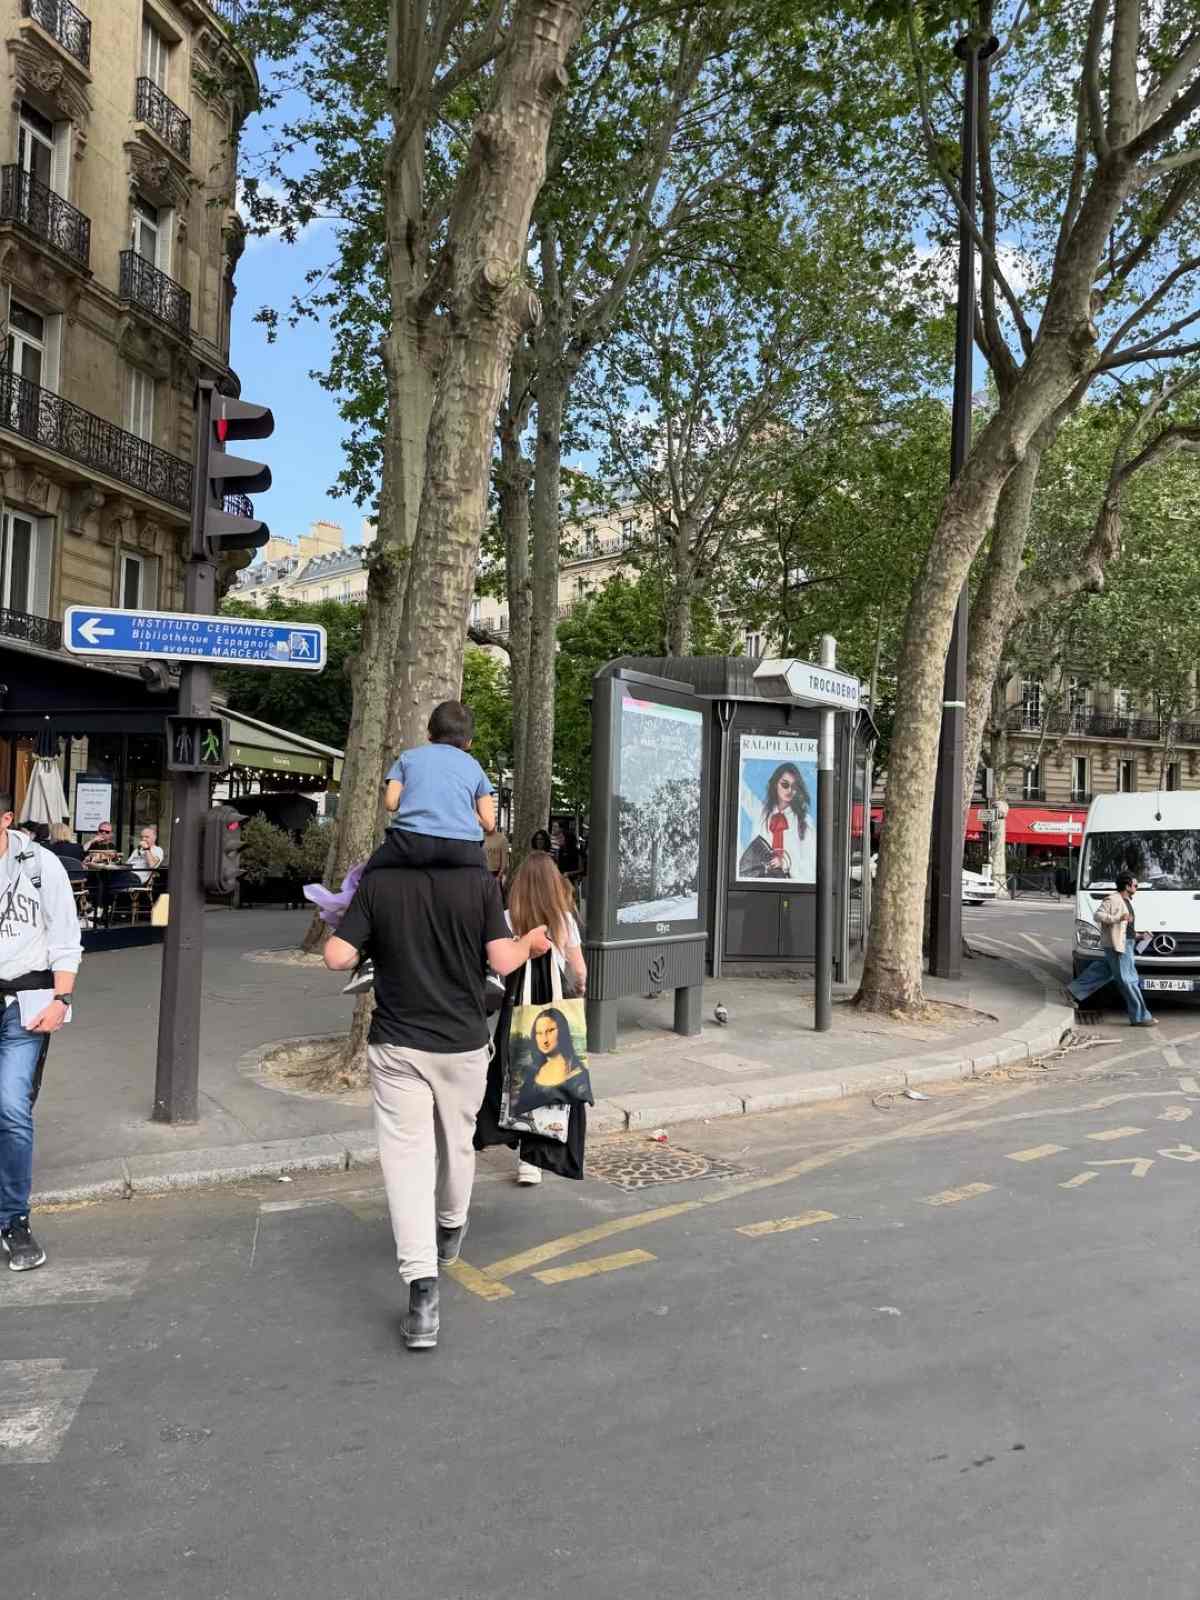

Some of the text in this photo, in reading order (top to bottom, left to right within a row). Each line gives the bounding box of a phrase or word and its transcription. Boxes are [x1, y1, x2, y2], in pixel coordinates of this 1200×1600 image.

[131, 618, 274, 637] INSTITUTO CERVANTES
[163, 643, 204, 654] avenue
[211, 647, 268, 659] MARCEAU
[809, 675, 857, 700] TROCADERO
[742, 739, 781, 753] RALPH
